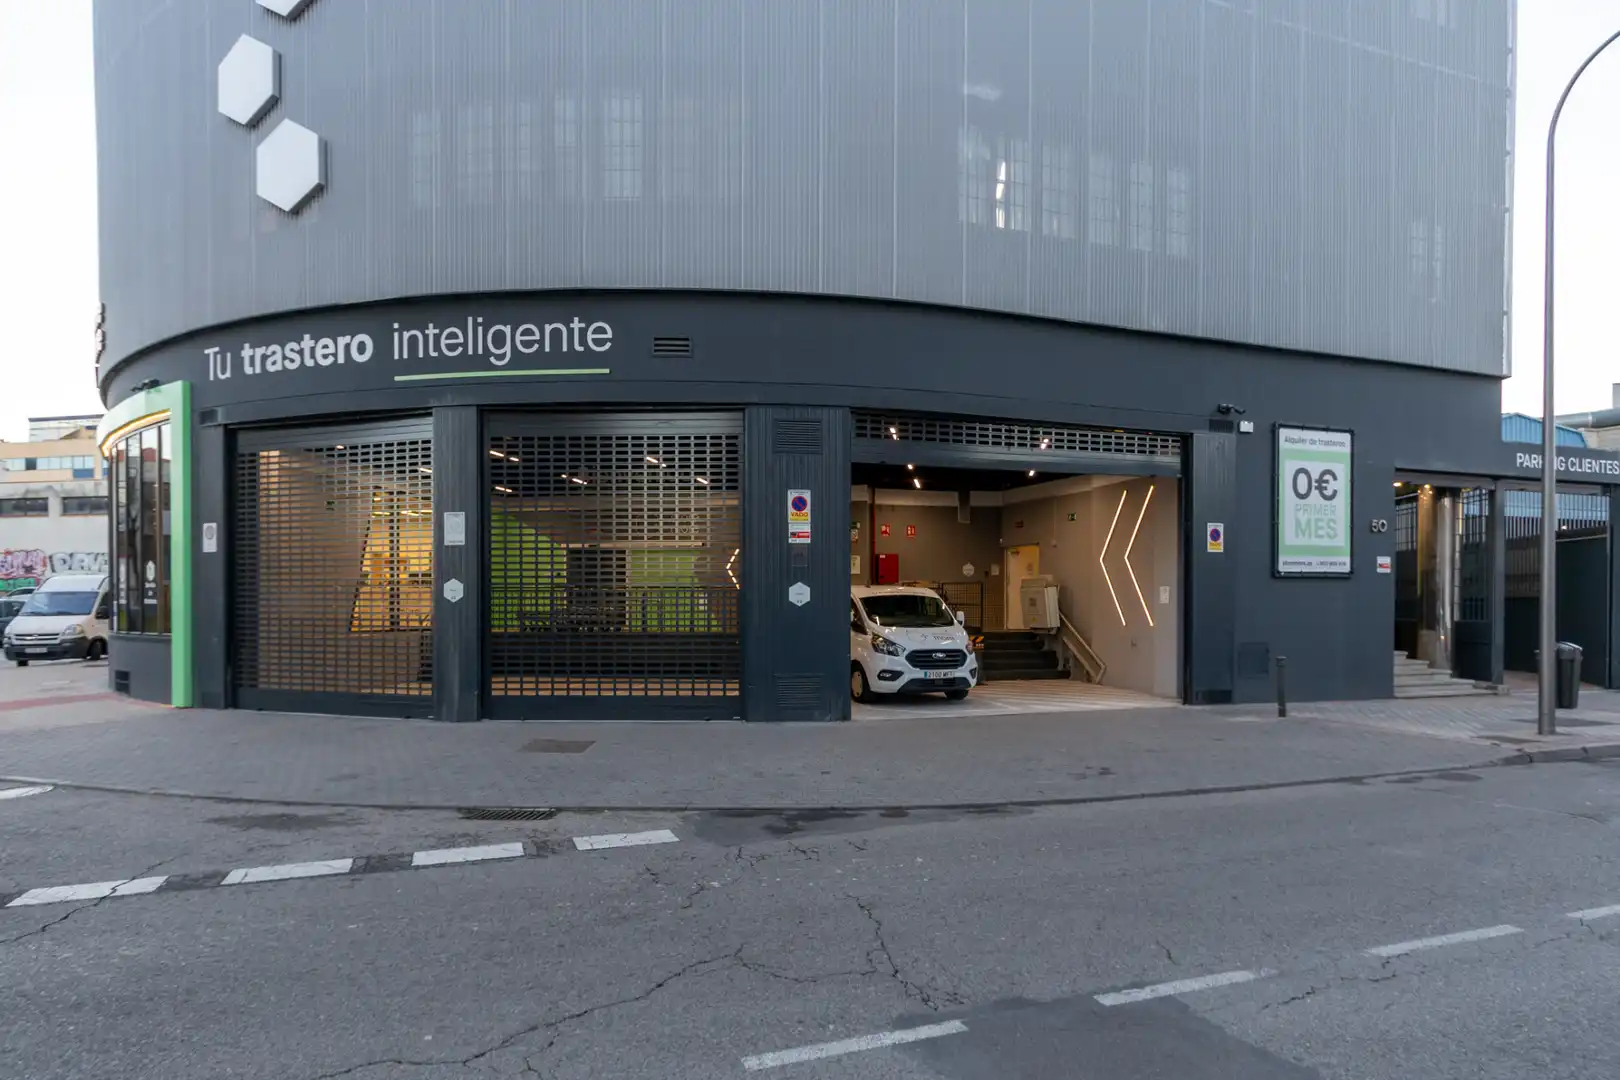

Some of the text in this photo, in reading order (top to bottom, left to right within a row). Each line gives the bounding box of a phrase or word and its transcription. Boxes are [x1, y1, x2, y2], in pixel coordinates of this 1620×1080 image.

[204, 316, 613, 381] Tu trastero inteligente
[1568, 457, 1620, 475] CLIENTES
[1292, 467, 1338, 501] 0€
[1295, 503, 1337, 517] PRIMER
[1294, 518, 1338, 540] MES
[1371, 519, 1388, 533] 50
